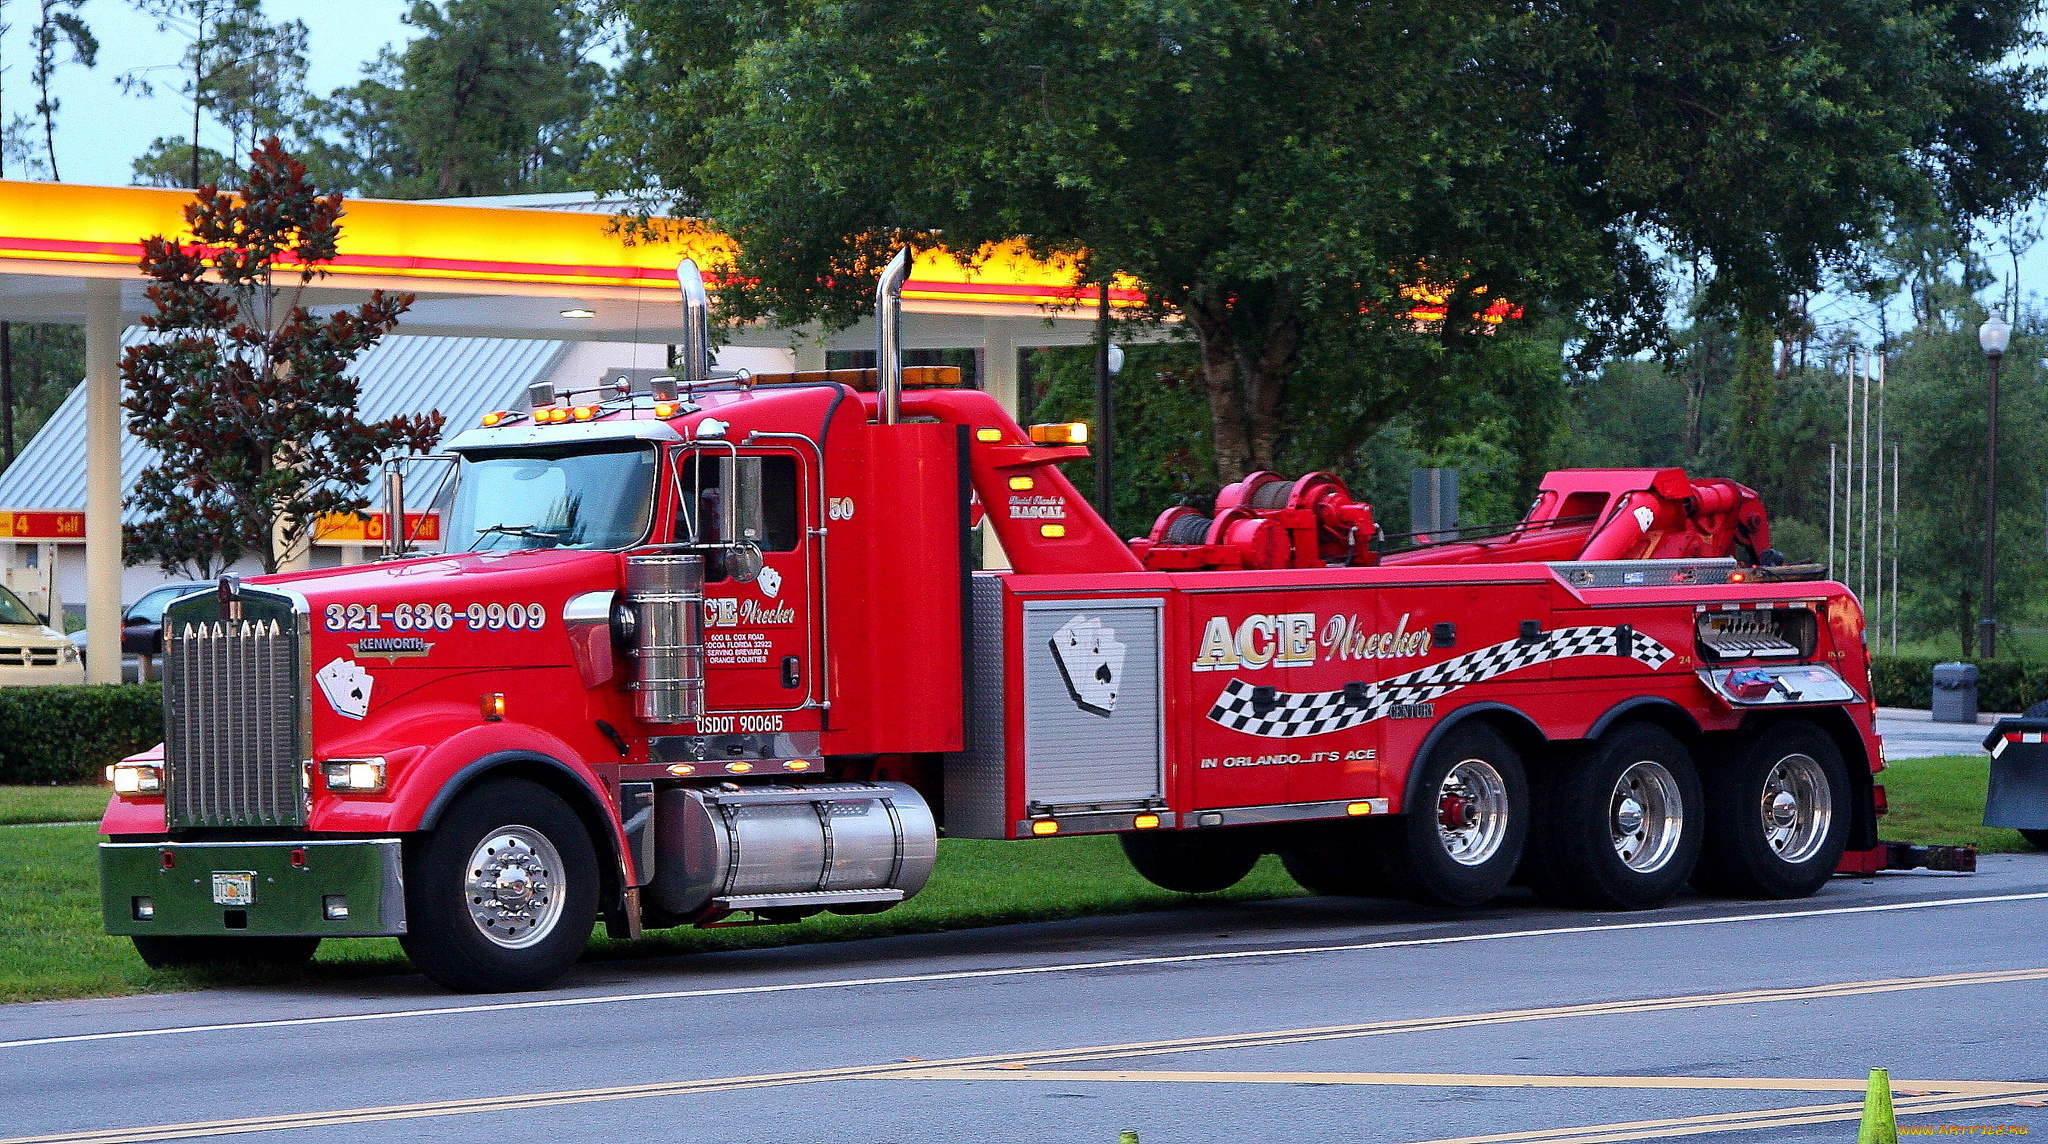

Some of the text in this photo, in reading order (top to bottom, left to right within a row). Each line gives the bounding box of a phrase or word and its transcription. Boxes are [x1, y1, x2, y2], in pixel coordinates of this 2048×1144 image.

[829, 497, 853, 520] 50
[1009, 506, 1066, 518] RASCAL
[16, 515, 78, 534] 4 Self
[368, 516, 381, 536] 6
[325, 603, 546, 632] 321-636-9909
[704, 598, 795, 627] CE Wrecker
[358, 638, 424, 652] KENWORTH
[747, 633, 765, 641] ROAD
[1192, 613, 1432, 672] ACE Wrecker
[736, 656, 767, 664] COUNTIES
[1679, 656, 1691, 664] 24
[1389, 703, 1436, 720] CENTURY
[697, 715, 783, 734] USDOT 900615
[1200, 758, 1218, 769] IN
[1344, 750, 1376, 761] ACE
